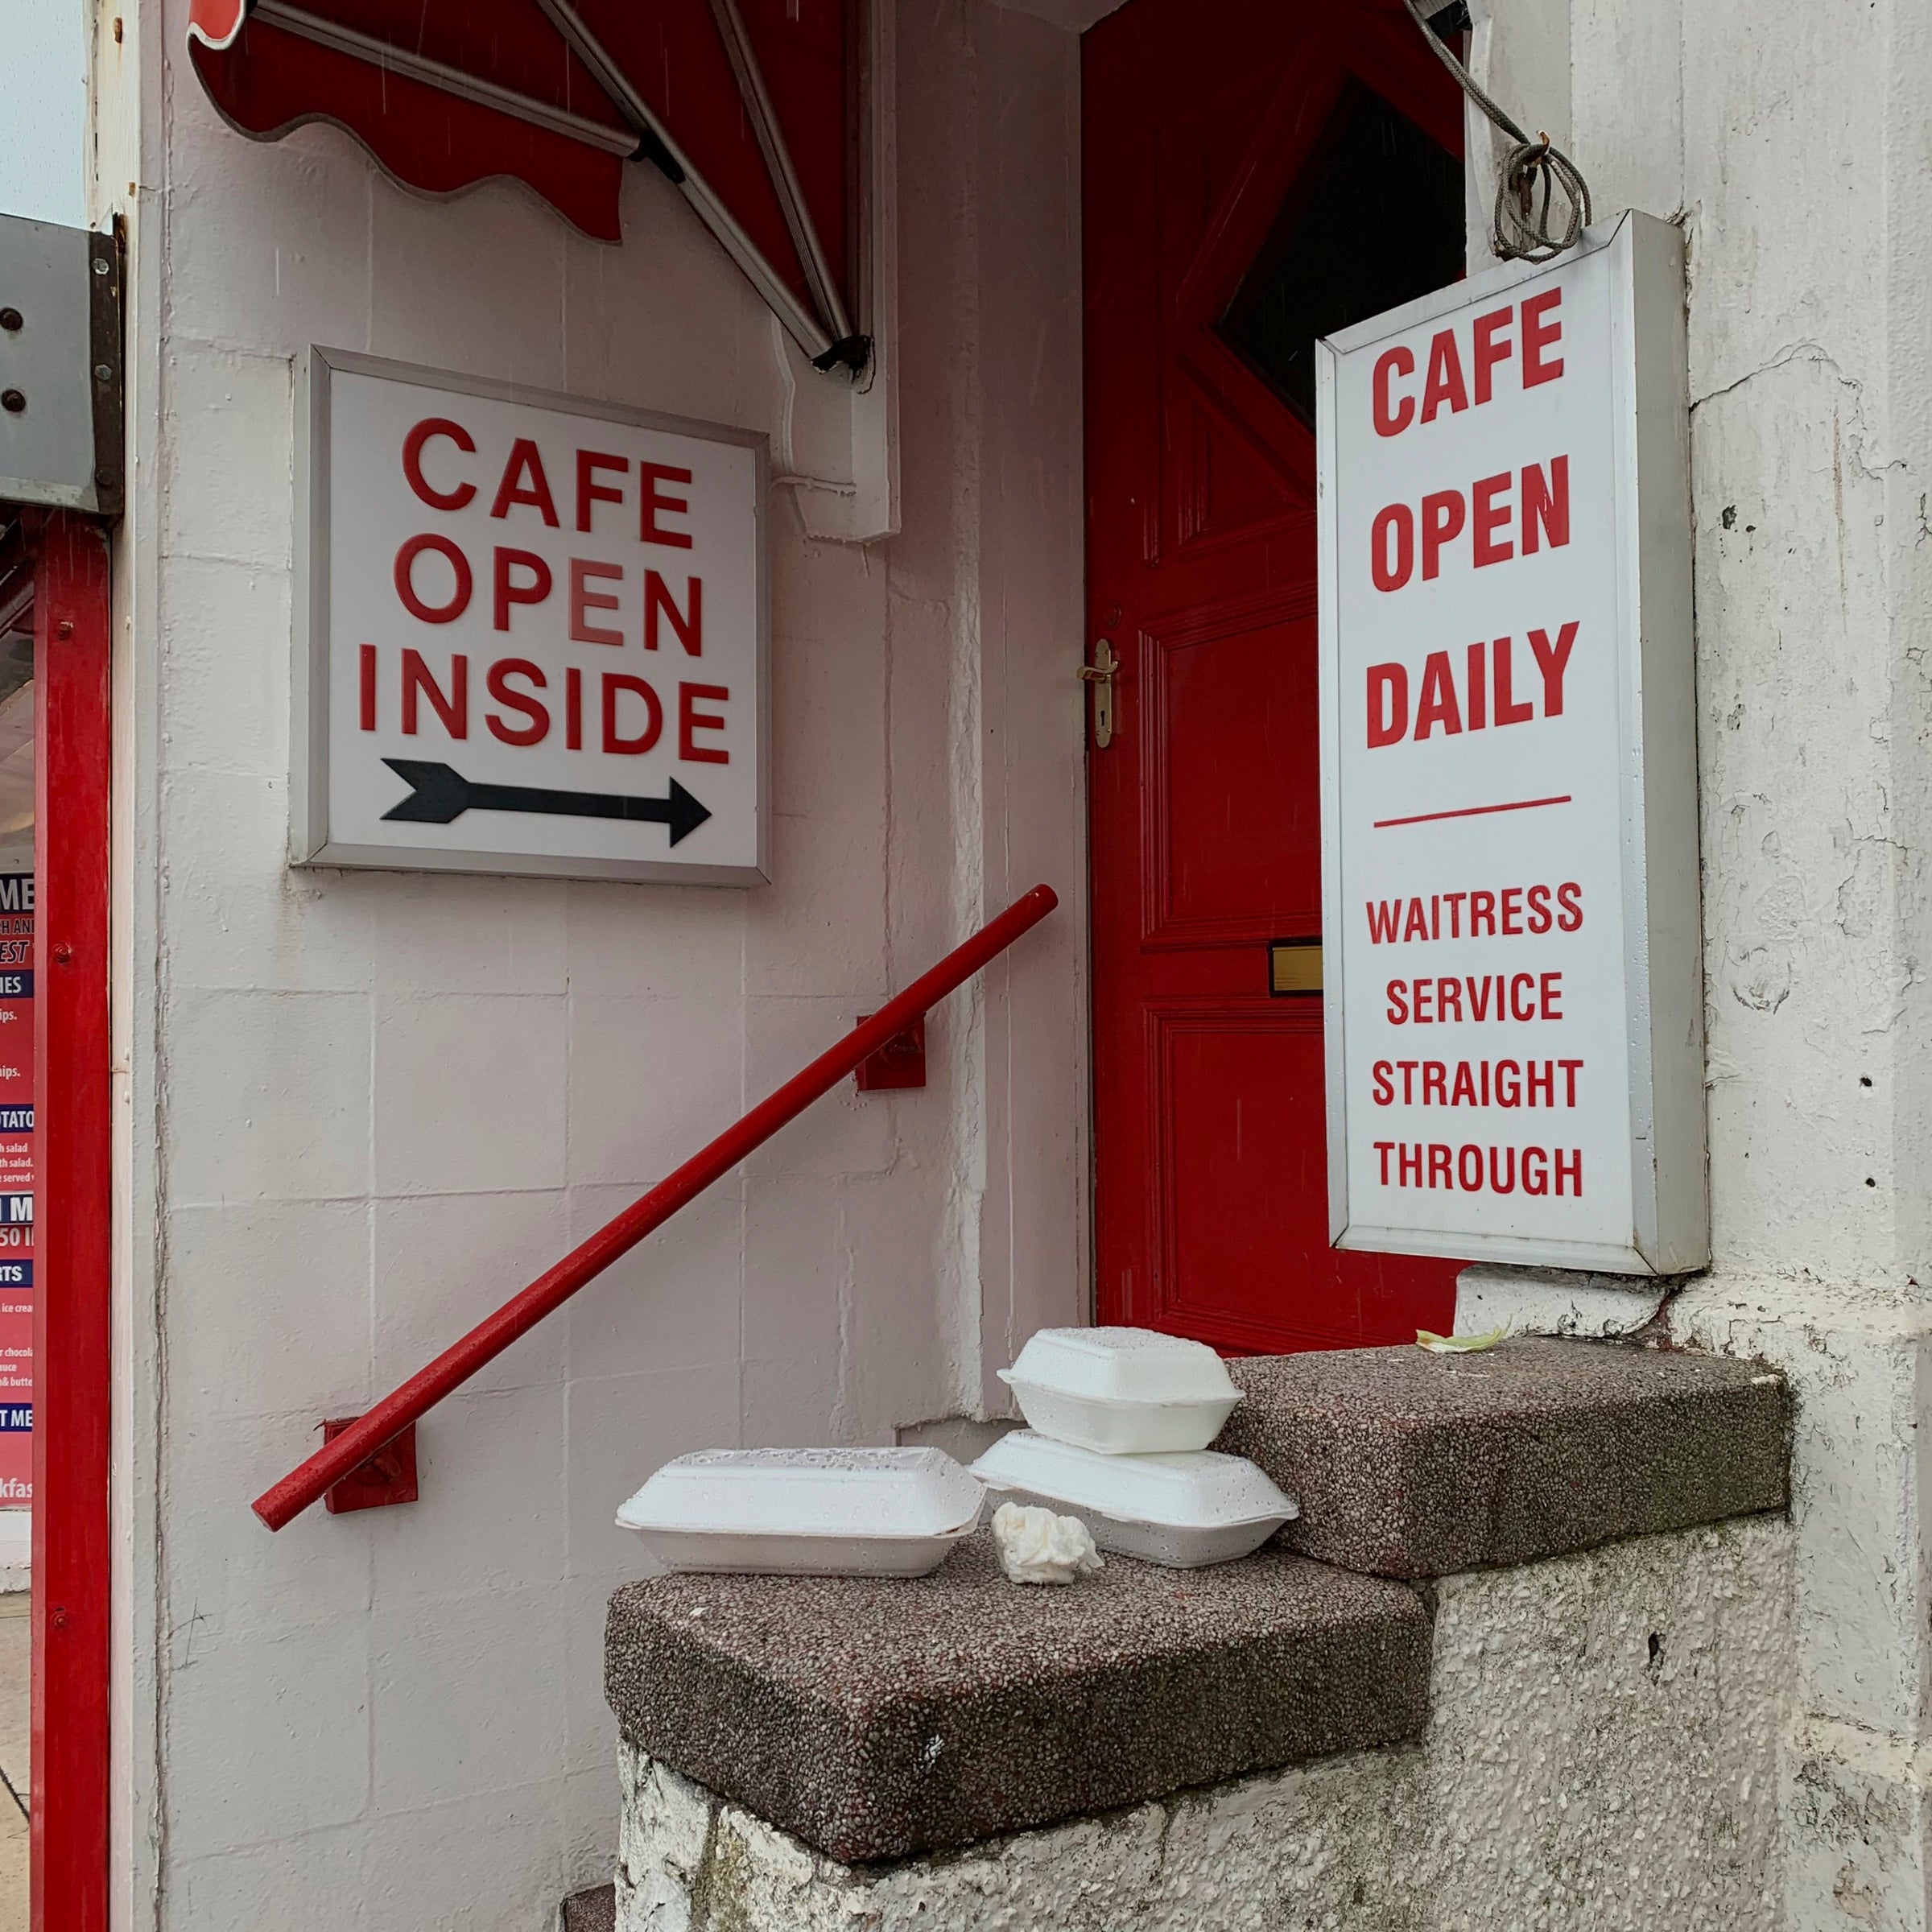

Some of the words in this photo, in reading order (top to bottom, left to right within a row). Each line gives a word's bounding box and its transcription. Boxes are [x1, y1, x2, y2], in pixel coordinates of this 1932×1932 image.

[1373, 287, 1564, 438] CAFE
[402, 418, 693, 550] CAFE
[1371, 455, 1570, 593] OPEN
[394, 533, 702, 658] OPEN
[359, 643, 730, 765] INSIDE
[1366, 621, 1579, 749] DAILY
[1366, 881, 1583, 945] WAITRESS
[1386, 972, 1563, 1026] SERVICE
[1372, 1059, 1584, 1108] STRAIGHT
[3, 1172, 31, 1182] served
[6, 1143, 27, 1153] salad
[1373, 1141, 1583, 1198] THROUGH
[2, 1303, 14, 1312] ice
